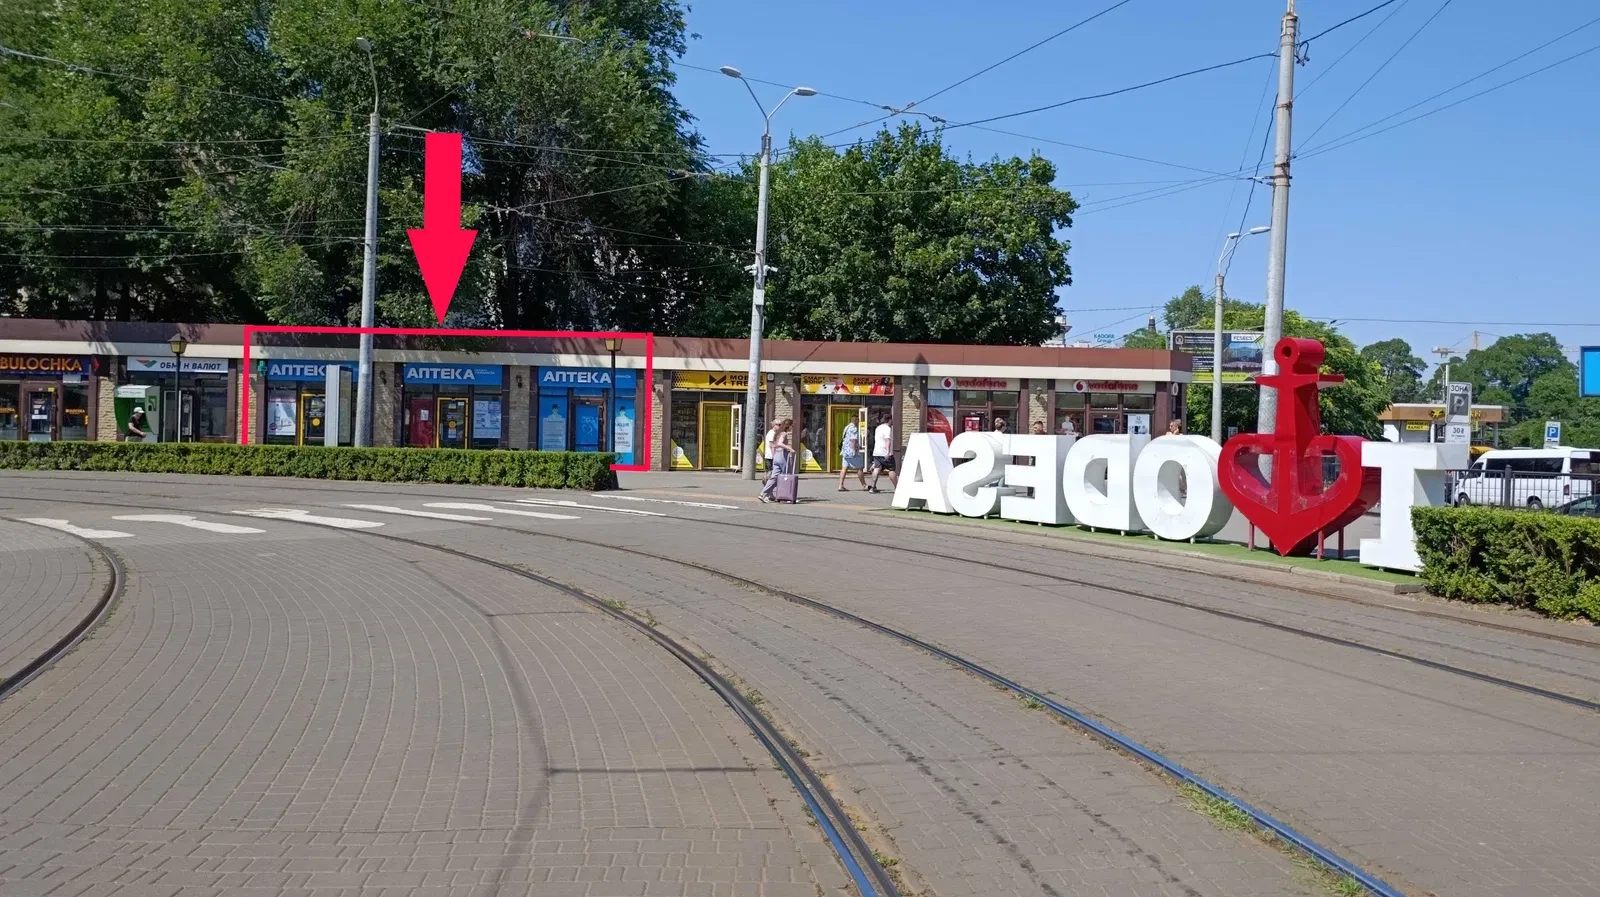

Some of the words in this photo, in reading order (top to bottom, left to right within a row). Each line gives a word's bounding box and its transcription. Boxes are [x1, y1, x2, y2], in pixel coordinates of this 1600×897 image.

[0, 357, 82, 371] BULOCHKA
[192, 362, 222, 370] ВАЛЮТ
[269, 364, 327, 376] АПТЕК
[406, 367, 475, 380] АПТЕКА
[543, 371, 611, 383] АПТЕКА
[956, 378, 1007, 388] vodafone
[1088, 380, 1138, 391] vodafone
[1453, 395, 1464, 412] P
[1548, 427, 1556, 437] P
